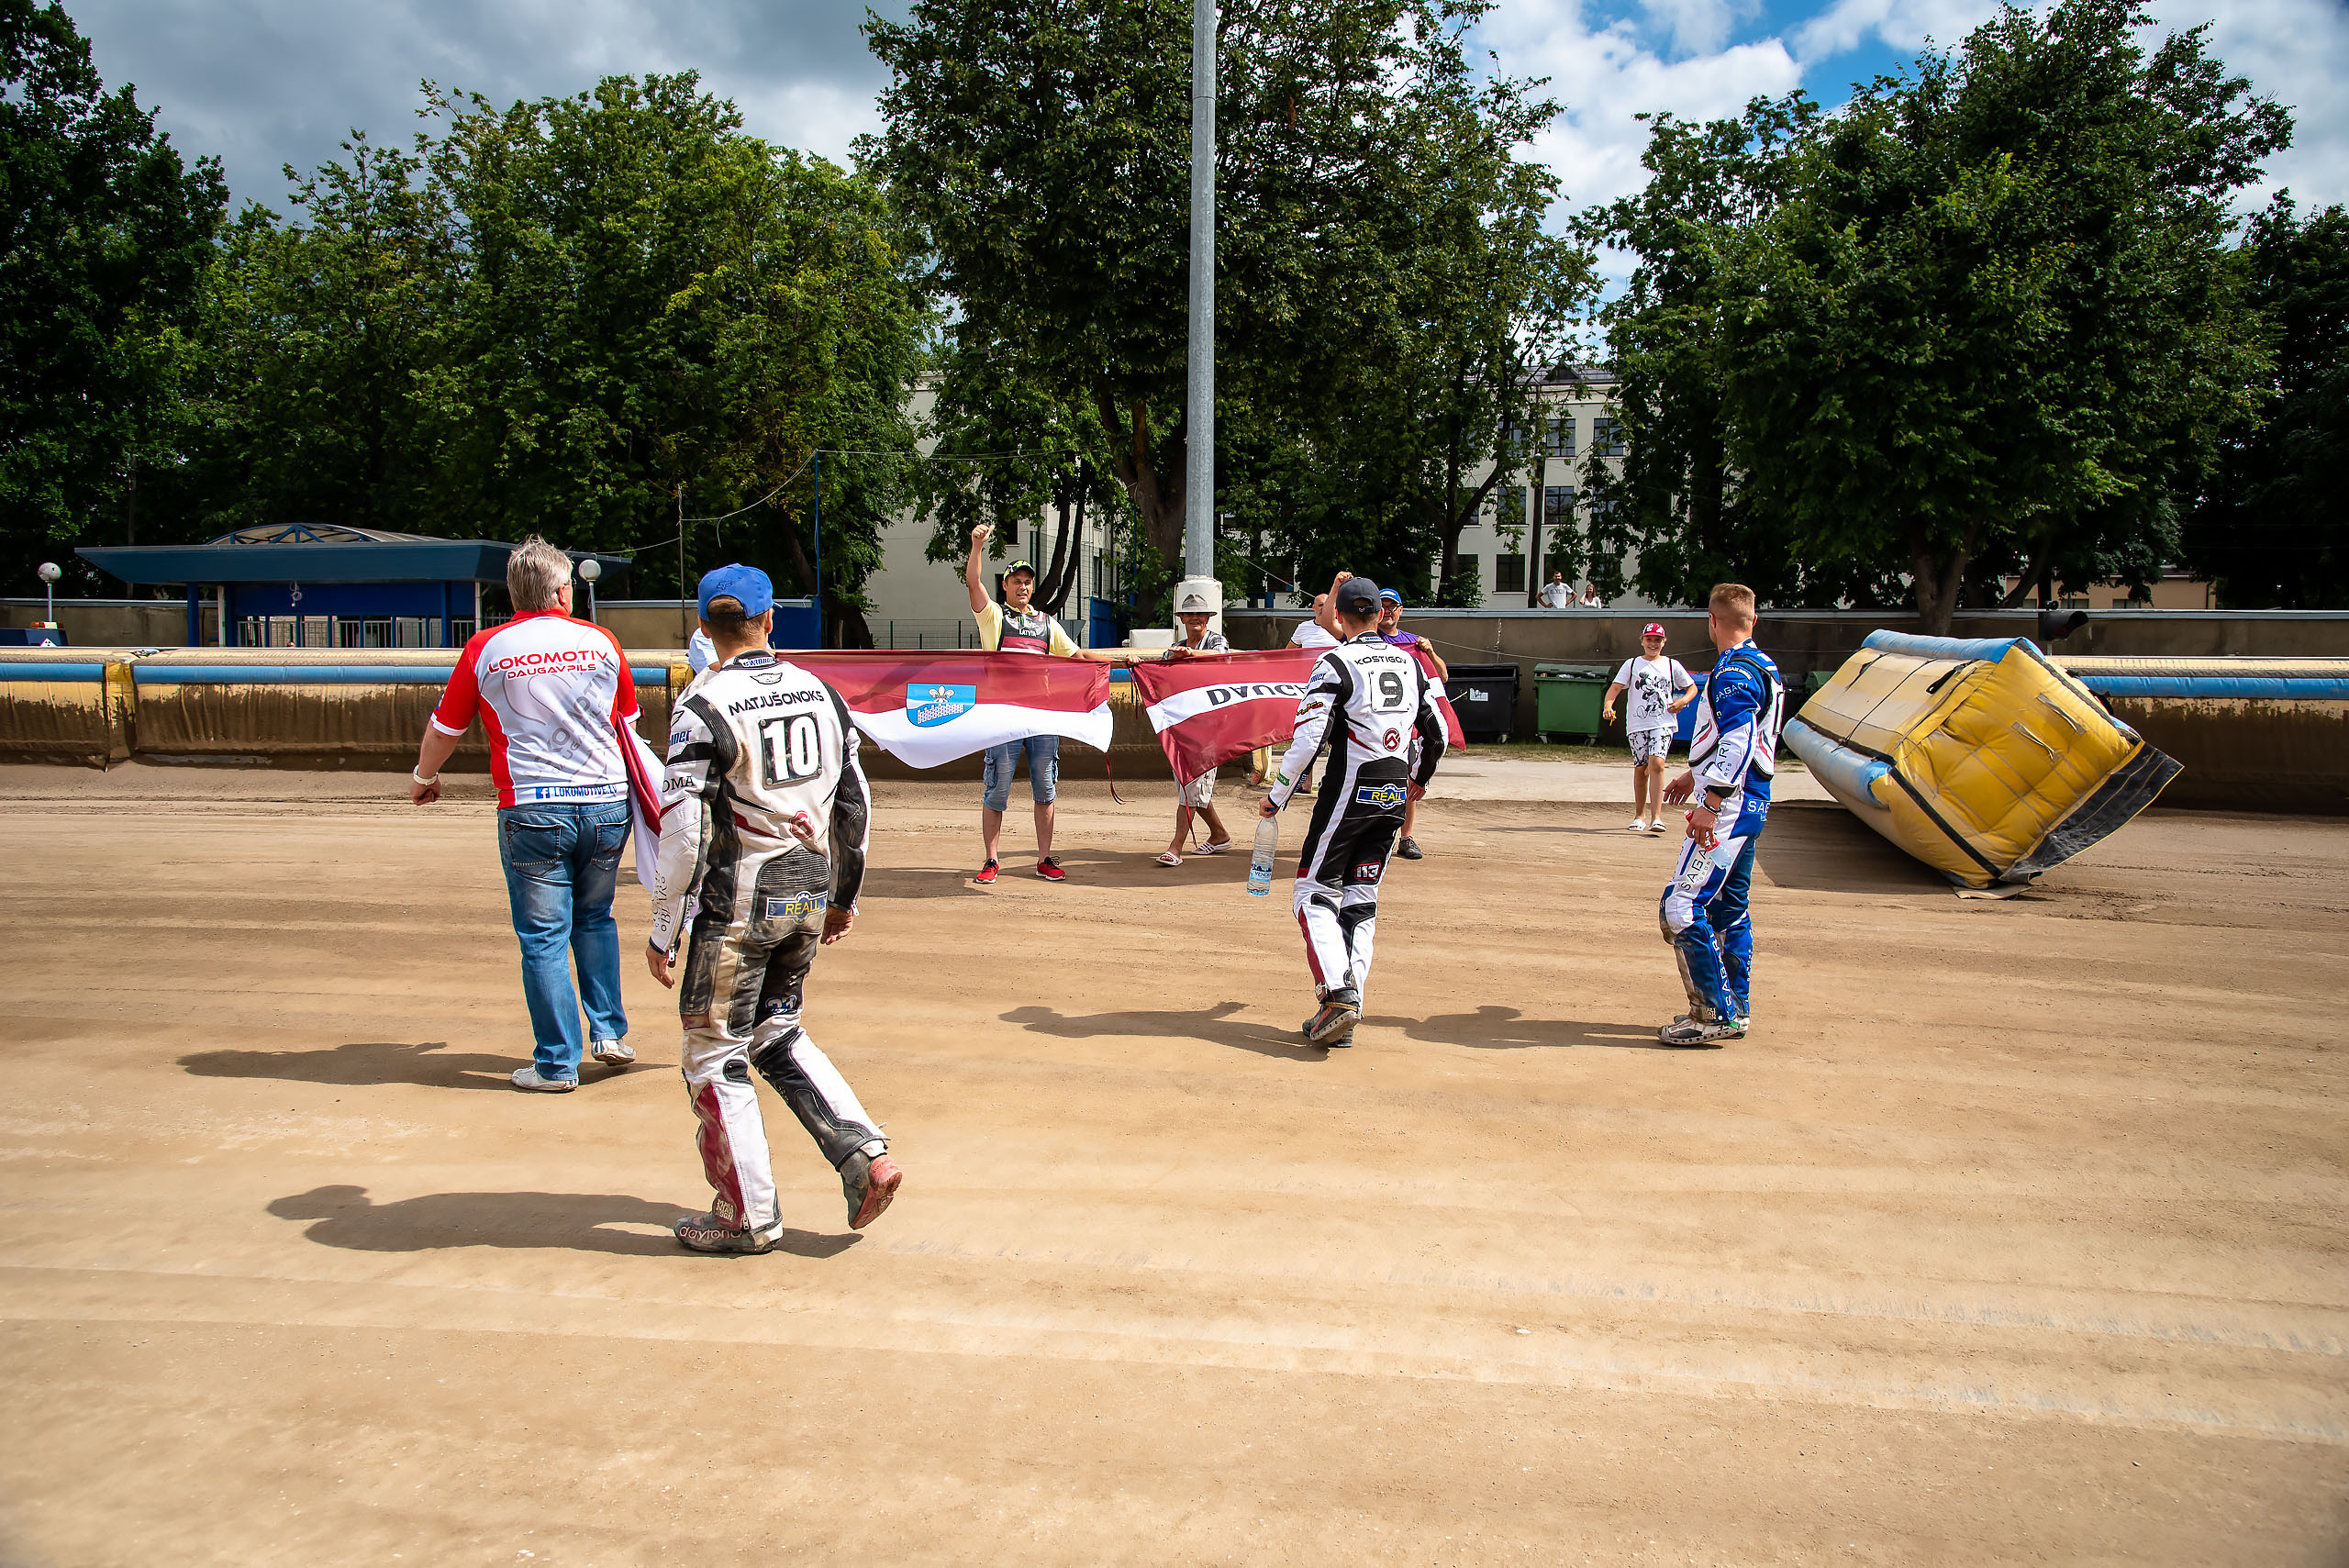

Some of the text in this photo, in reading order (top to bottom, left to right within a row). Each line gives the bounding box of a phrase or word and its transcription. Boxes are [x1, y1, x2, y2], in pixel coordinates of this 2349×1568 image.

[488, 651, 607, 673] LOKOMOTIV
[507, 664, 596, 680] DAUGAVPILS
[1378, 672, 1404, 707] 9
[728, 691, 825, 716] MATJUŠONOKS
[763, 716, 820, 781] 10
[1356, 864, 1380, 878] 113
[785, 899, 820, 916] REALL
